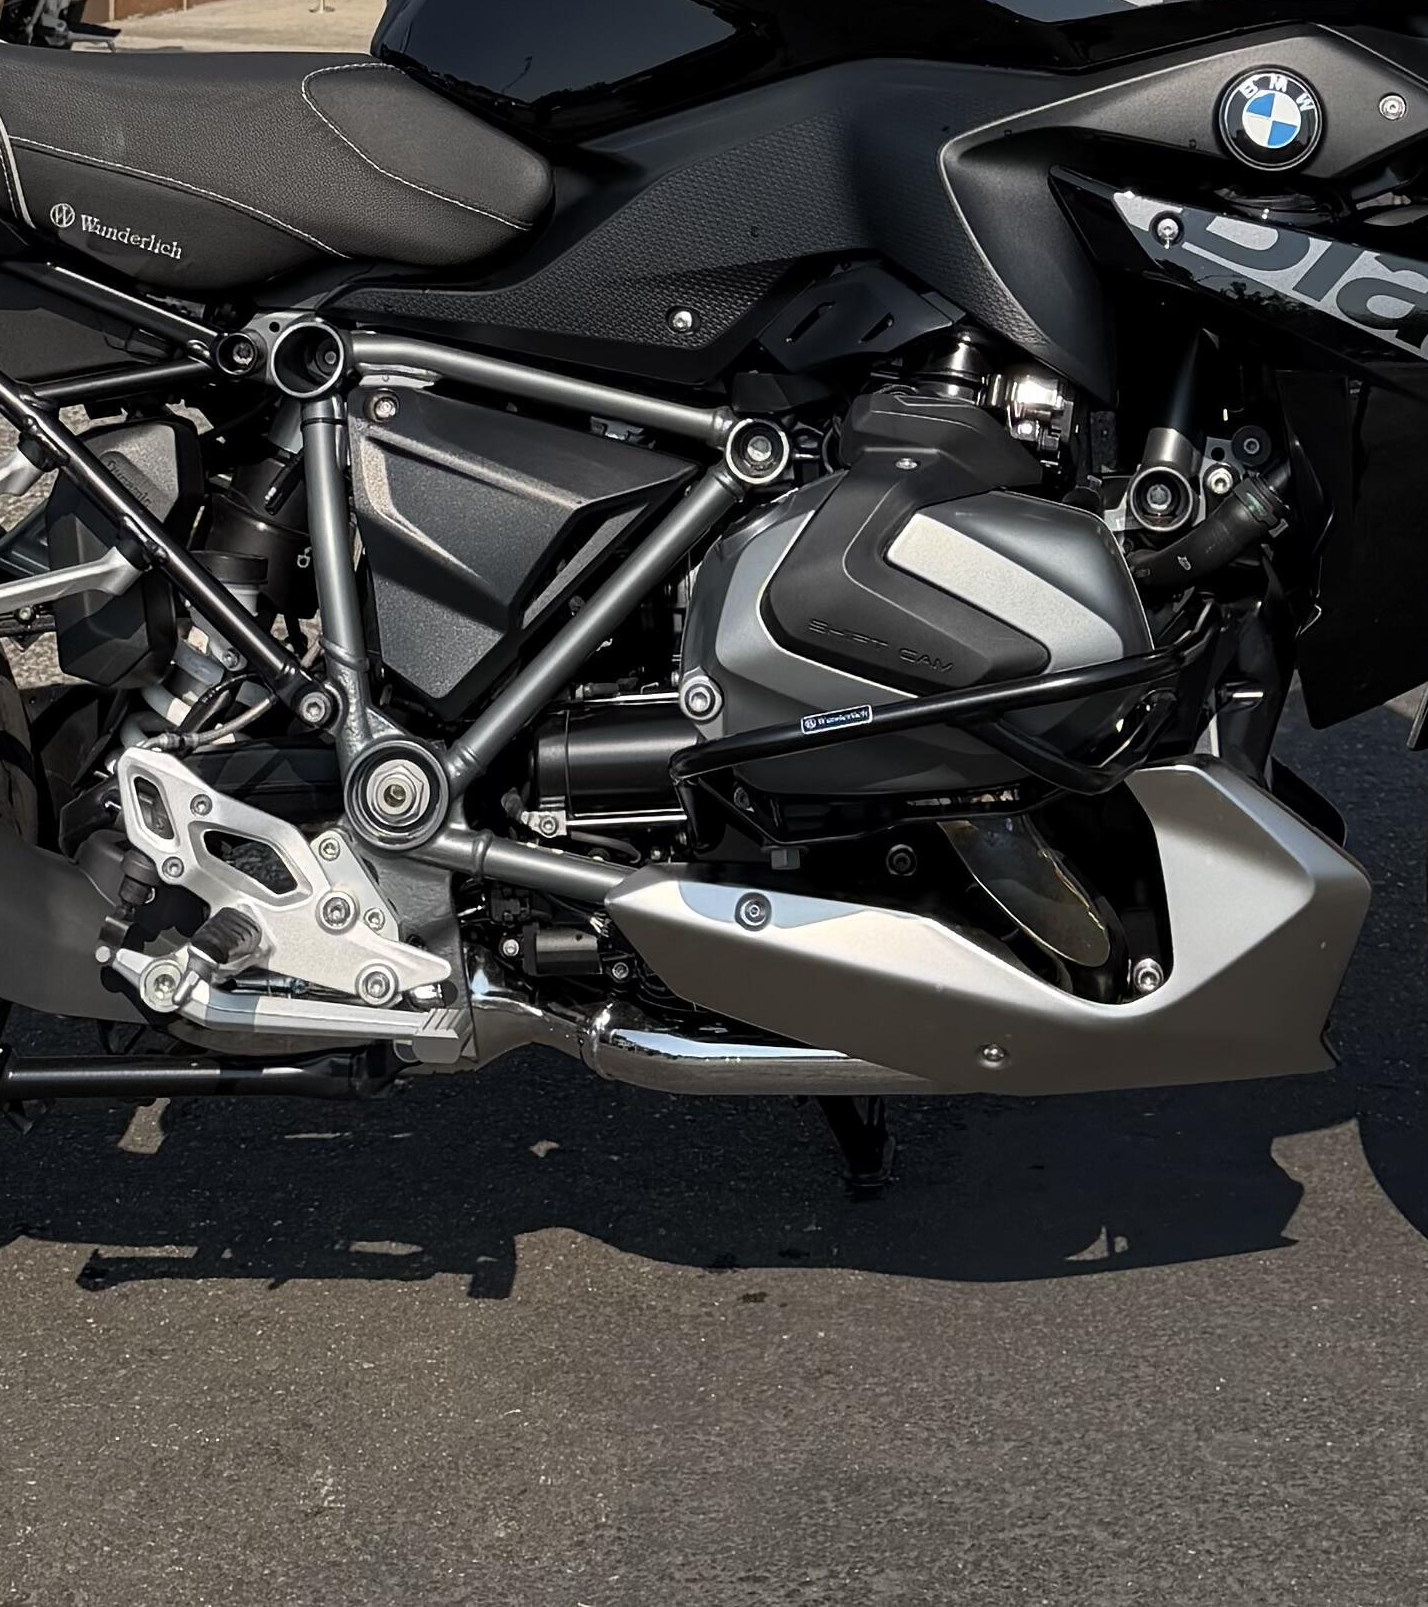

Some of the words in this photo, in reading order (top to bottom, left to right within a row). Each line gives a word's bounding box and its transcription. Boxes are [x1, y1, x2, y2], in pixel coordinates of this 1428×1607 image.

[1237, 73, 1316, 112] BMW
[80, 214, 183, 260] Wunderlich
[899, 647, 955, 675] CAM
